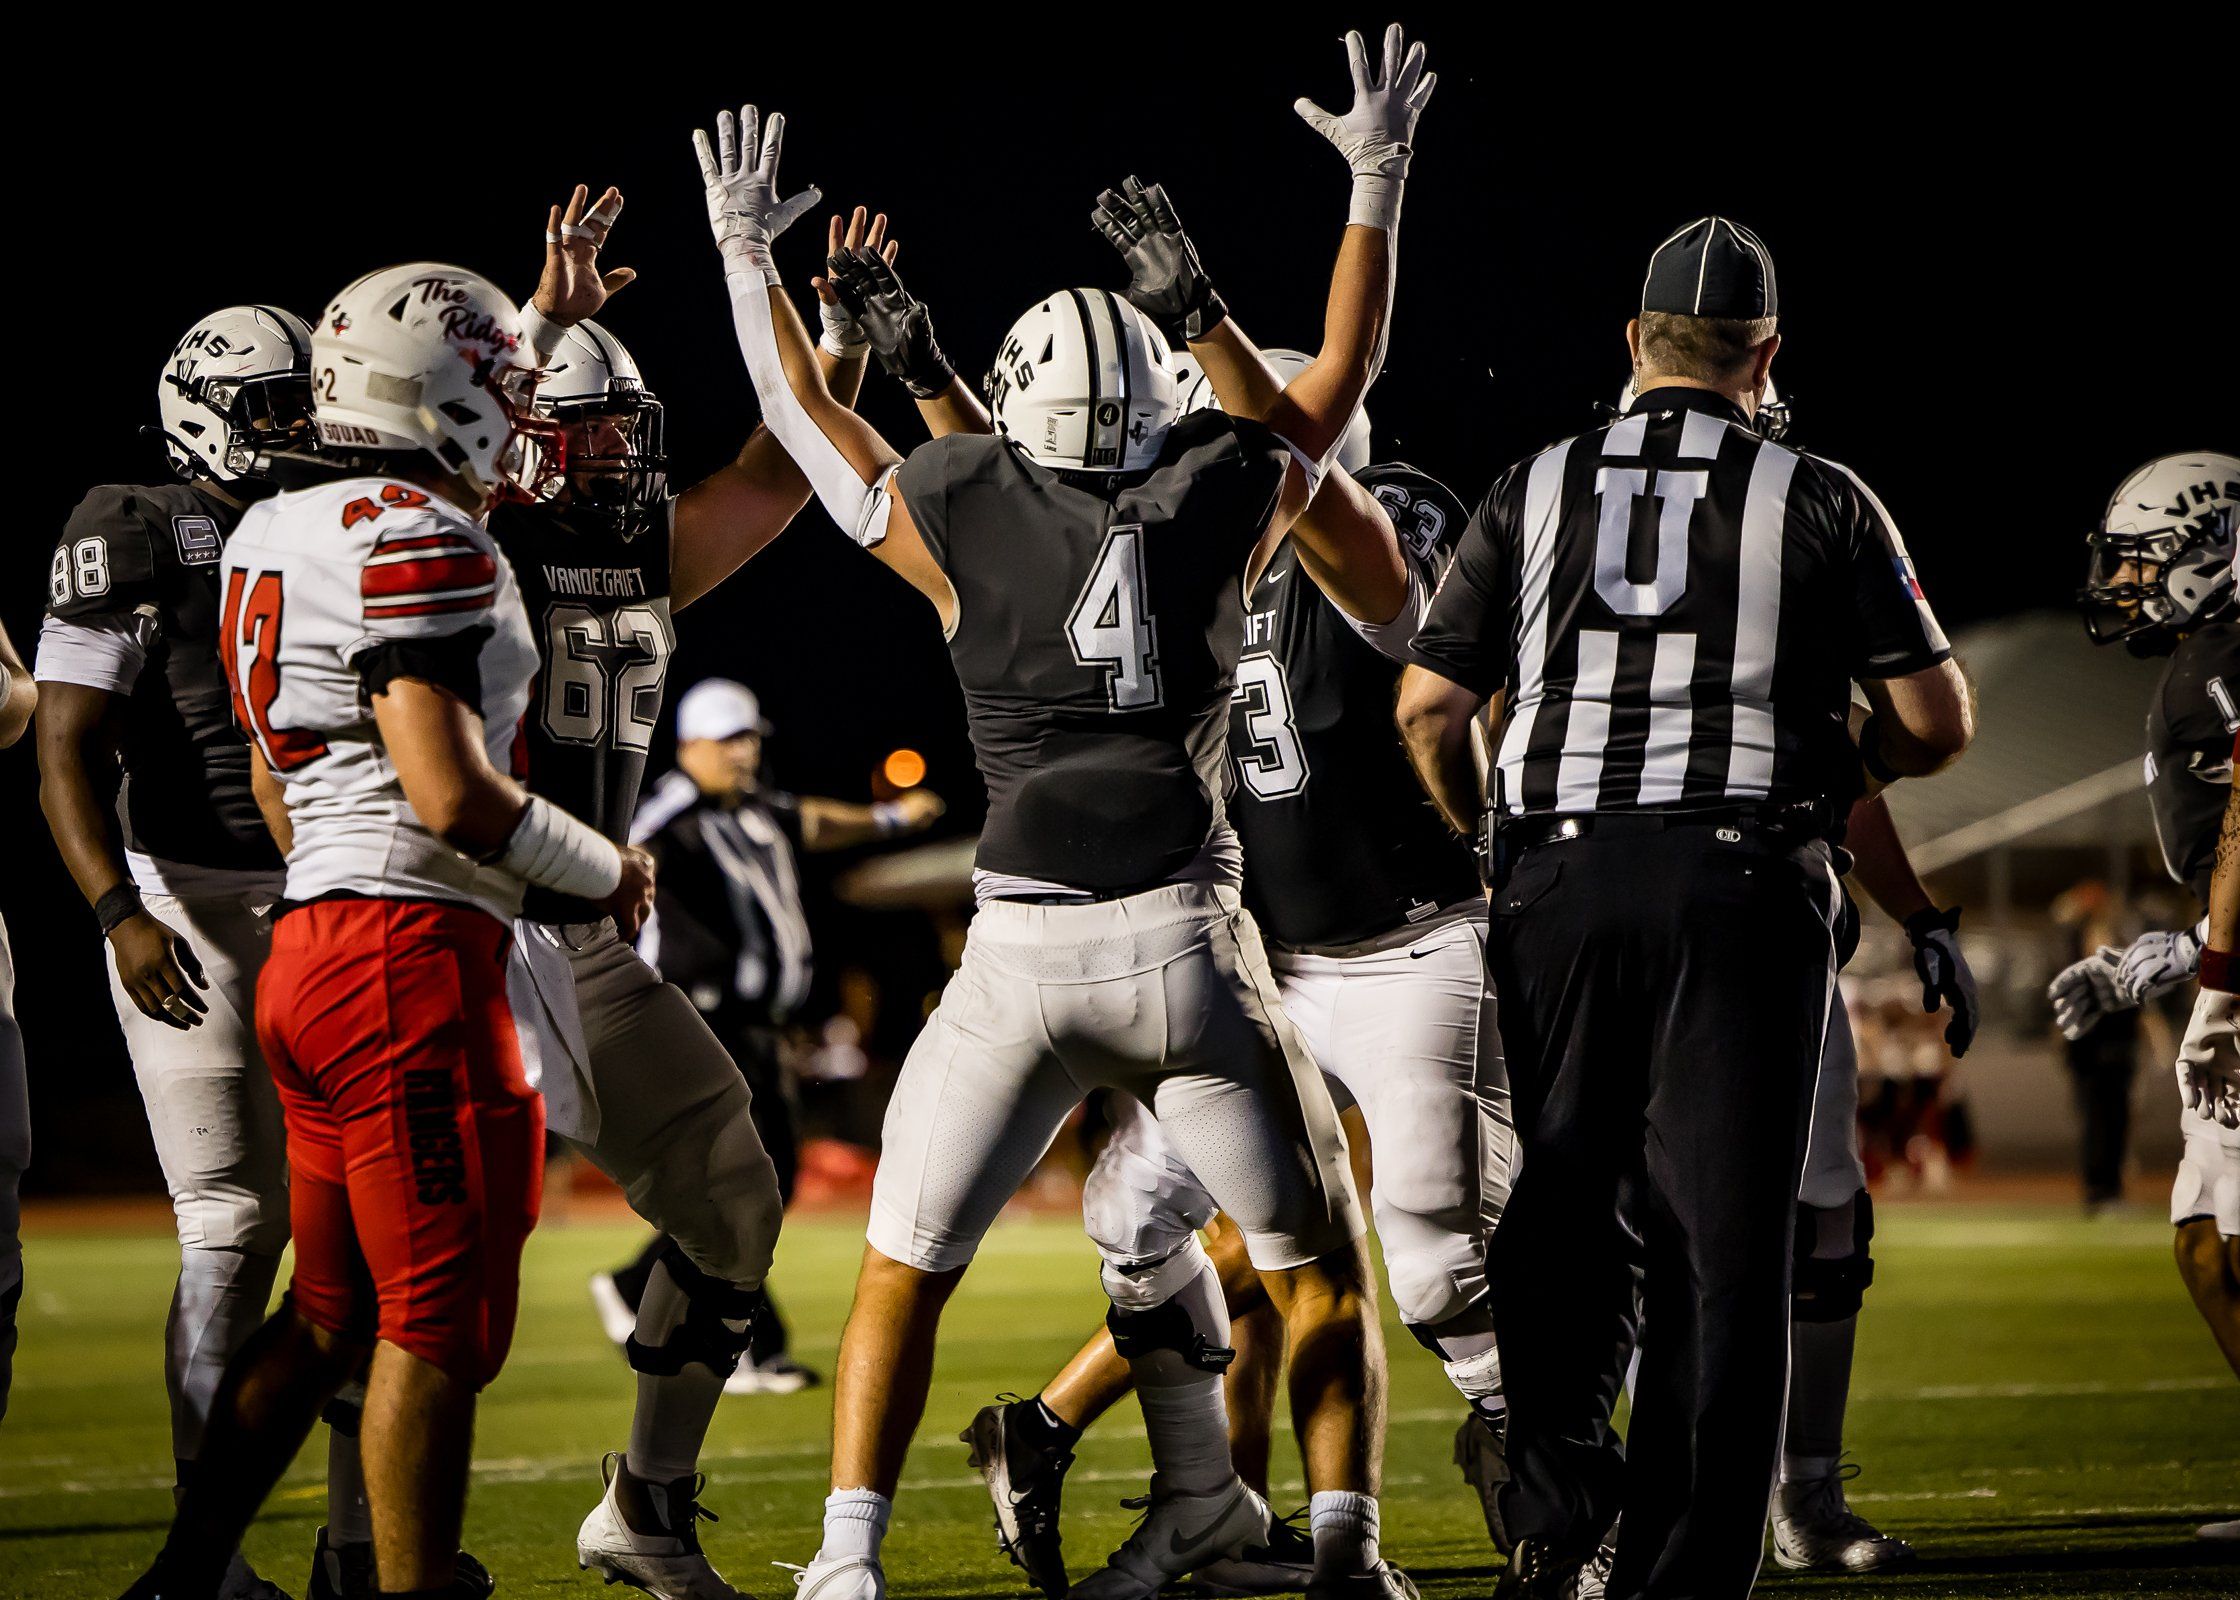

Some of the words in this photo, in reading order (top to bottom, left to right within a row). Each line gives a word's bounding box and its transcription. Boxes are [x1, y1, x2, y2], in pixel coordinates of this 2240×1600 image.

[412, 278, 469, 304] The
[1103, 406, 1113, 424] 4
[325, 422, 380, 446] SQUAD
[180, 518, 217, 548] C
[1594, 468, 1709, 615] U
[542, 564, 646, 597] VANDEGRIFT
[1064, 523, 1164, 714] 4
[1243, 610, 1277, 647] IFT
[540, 601, 671, 756] 62
[1222, 650, 1311, 803] 3
